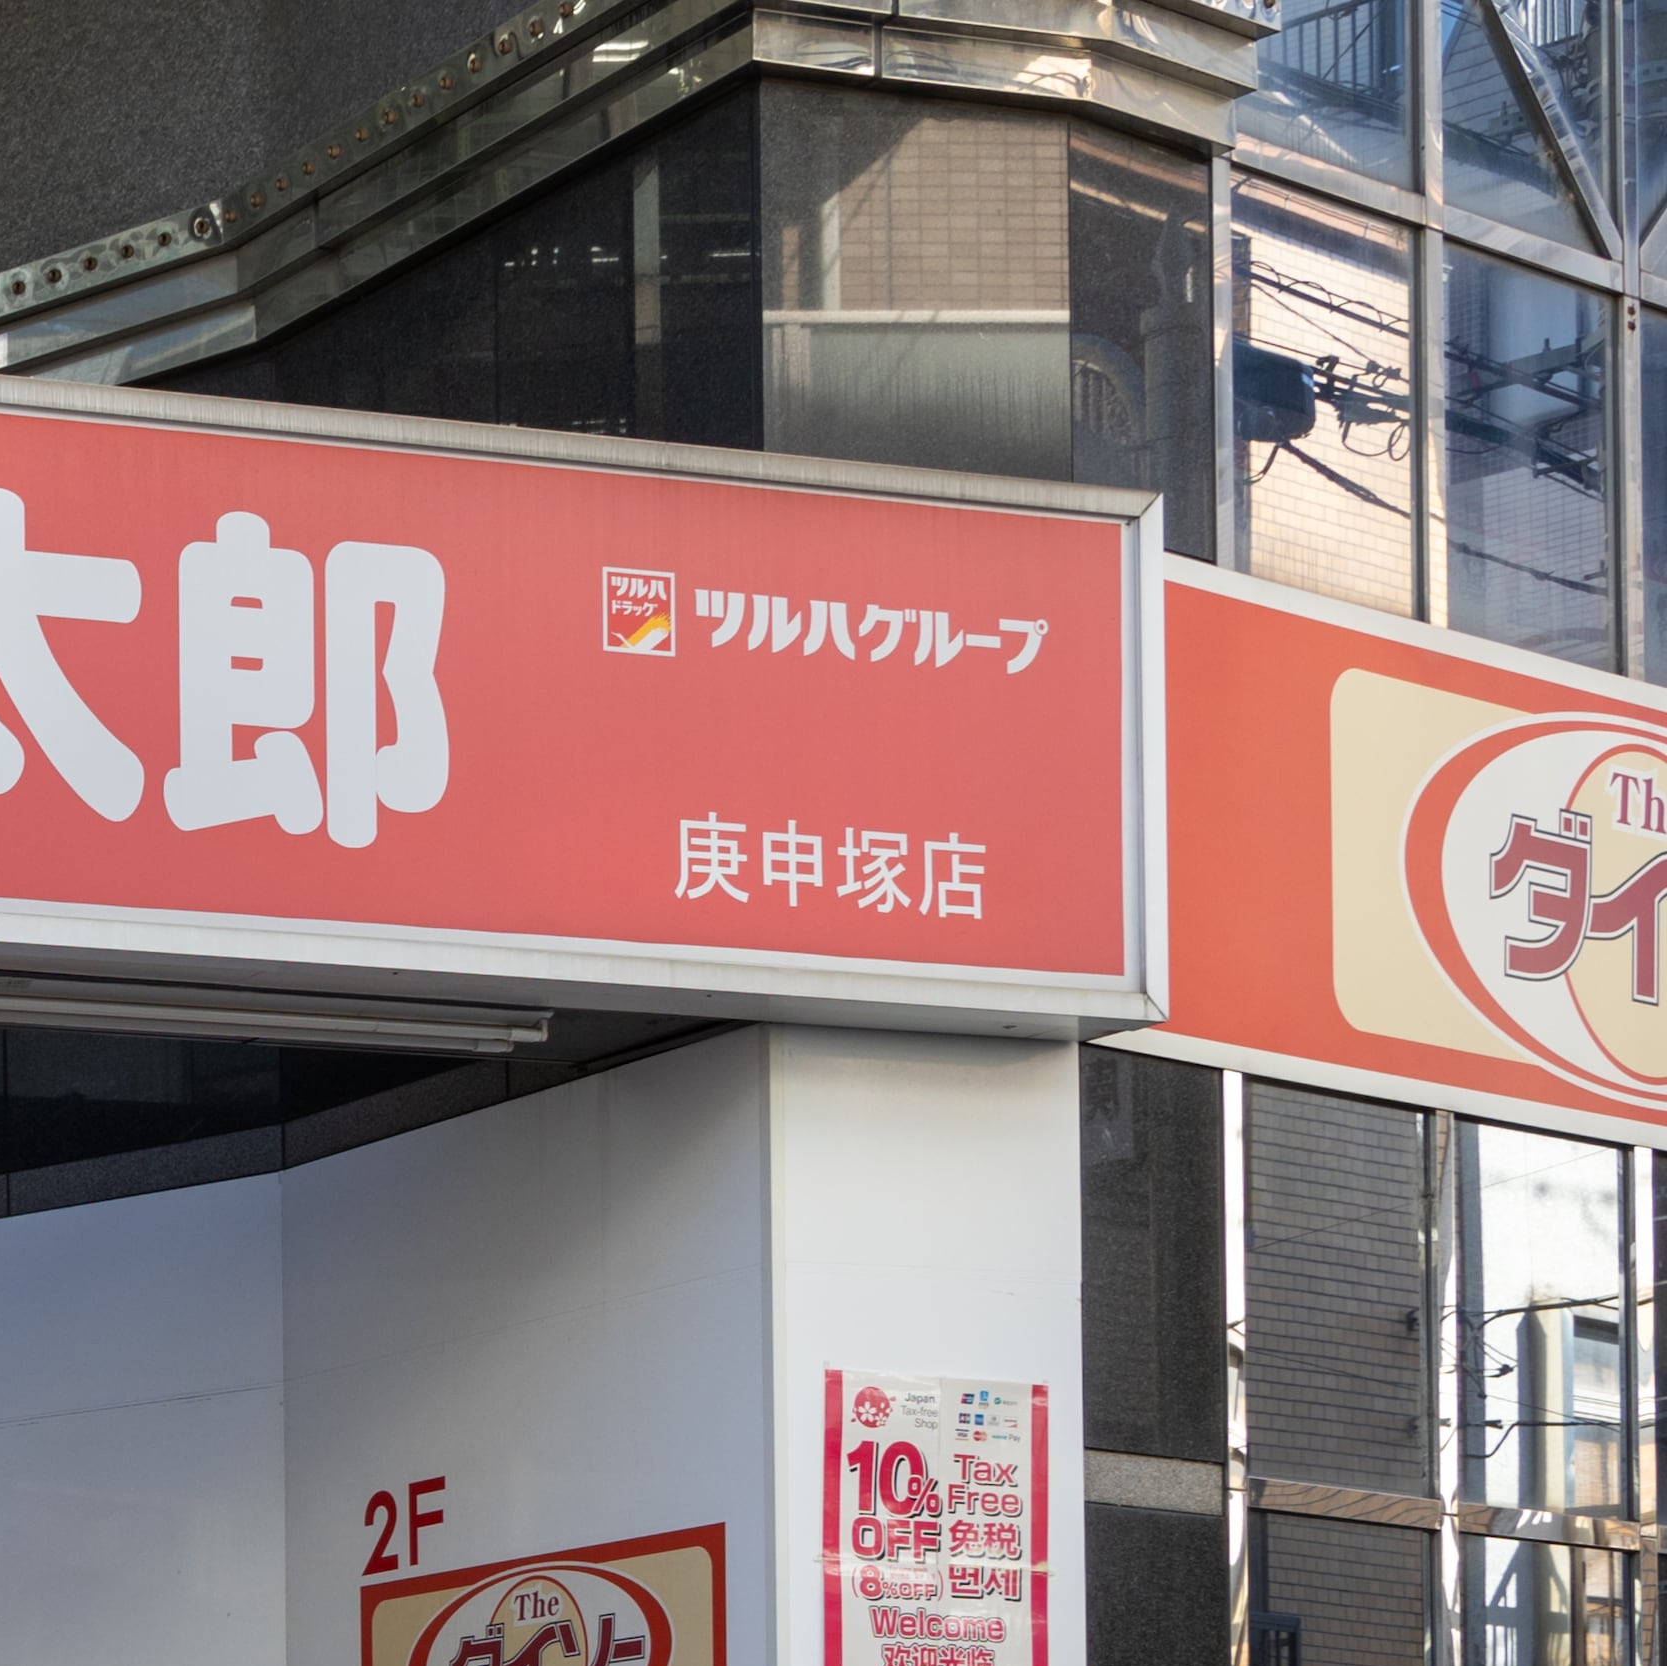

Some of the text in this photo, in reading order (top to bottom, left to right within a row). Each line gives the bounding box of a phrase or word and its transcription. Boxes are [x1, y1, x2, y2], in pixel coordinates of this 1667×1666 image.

[611, 575, 667, 601] ツルハ
[611, 599, 658, 618] ドラッグ
[694, 588, 1049, 675] ツルハグループ
[674, 812, 988, 921] 庚申塚店
[847, 1440, 942, 1517] 10%
[953, 1453, 1018, 1487] Tax
[947, 1483, 1022, 1516] Free
[362, 1475, 446, 1577] 2F
[850, 1516, 941, 1563] OFF
[948, 1519, 1022, 1560] 免税
[513, 1590, 560, 1622] The
[870, 1605, 1007, 1644] Welcome
